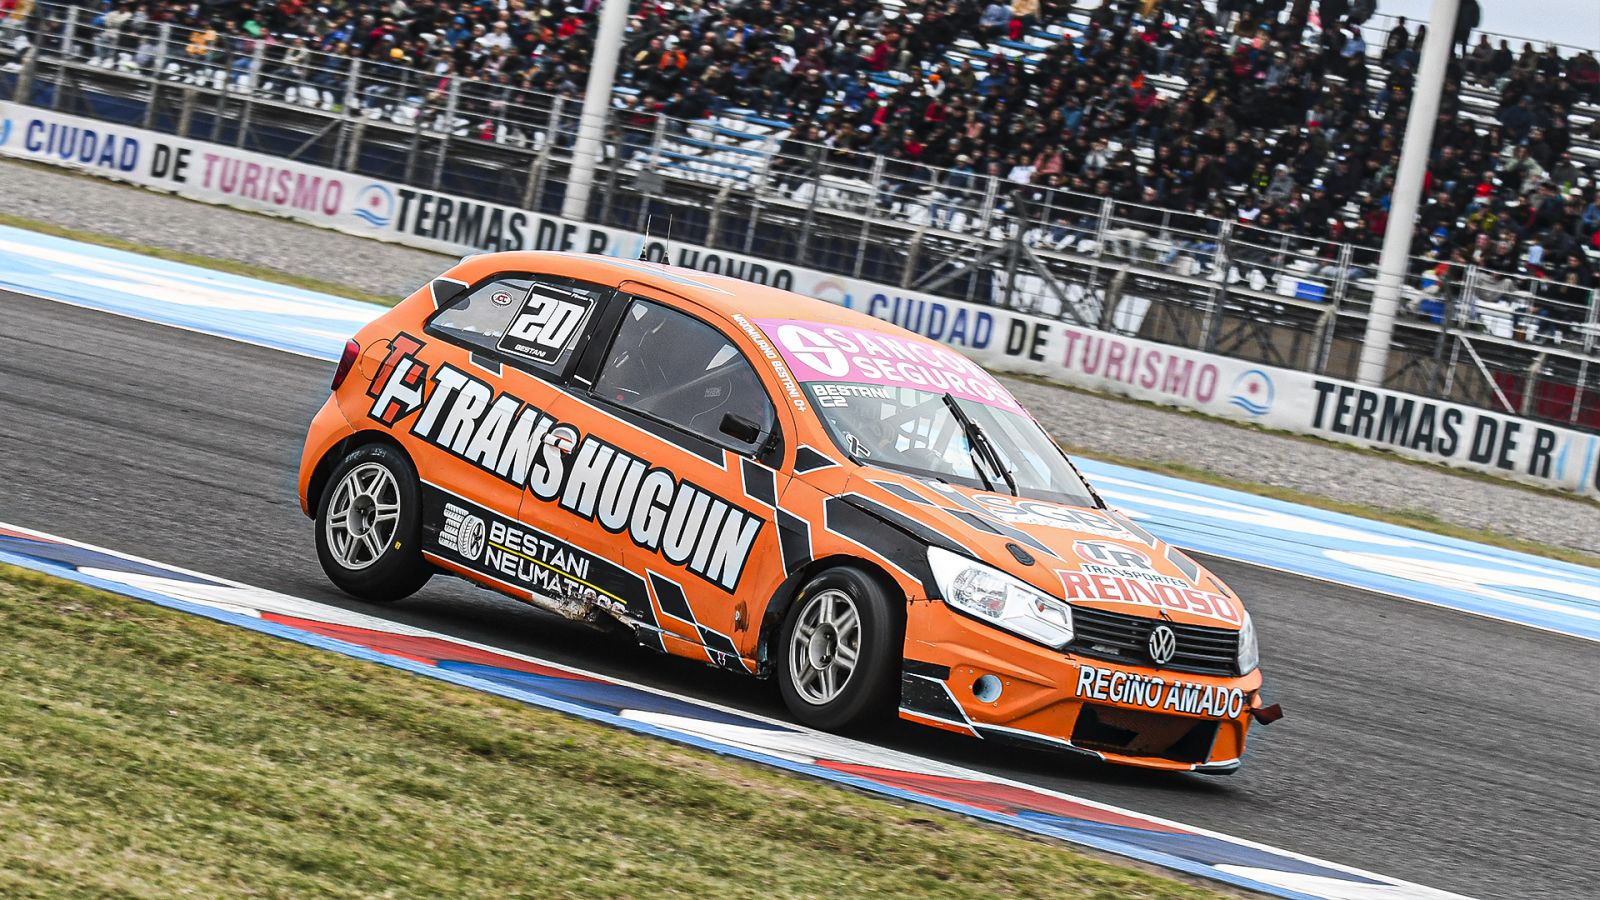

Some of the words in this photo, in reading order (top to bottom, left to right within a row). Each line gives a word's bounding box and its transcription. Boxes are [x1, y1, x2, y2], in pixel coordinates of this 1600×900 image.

[25, 119, 140, 172] CIUDAD
[150, 143, 192, 184] DE
[202, 153, 344, 217] TURISMO
[396, 188, 528, 252] TERMAS
[536, 218, 577, 252] DE
[507, 293, 586, 349] 20
[867, 293, 994, 349] CIUDAD
[1005, 318, 1050, 362] DE
[1061, 329, 1220, 403] TURISMO
[514, 344, 547, 358] BESTANI
[731, 313, 778, 359] MAXIMILIANO
[771, 361, 800, 398] BESTANI
[812, 384, 890, 399] BESTANI
[852, 356, 1016, 409] SEGUROS
[1313, 381, 1462, 457] TERMAS
[1469, 414, 1522, 470] DE
[488, 521, 590, 580] BESTANI
[1082, 564, 1190, 588] TRANSPORTES
[1061, 571, 1239, 623] REINOSO
[1076, 665, 1164, 708] REGINO
[1164, 680, 1243, 719] AMADO
